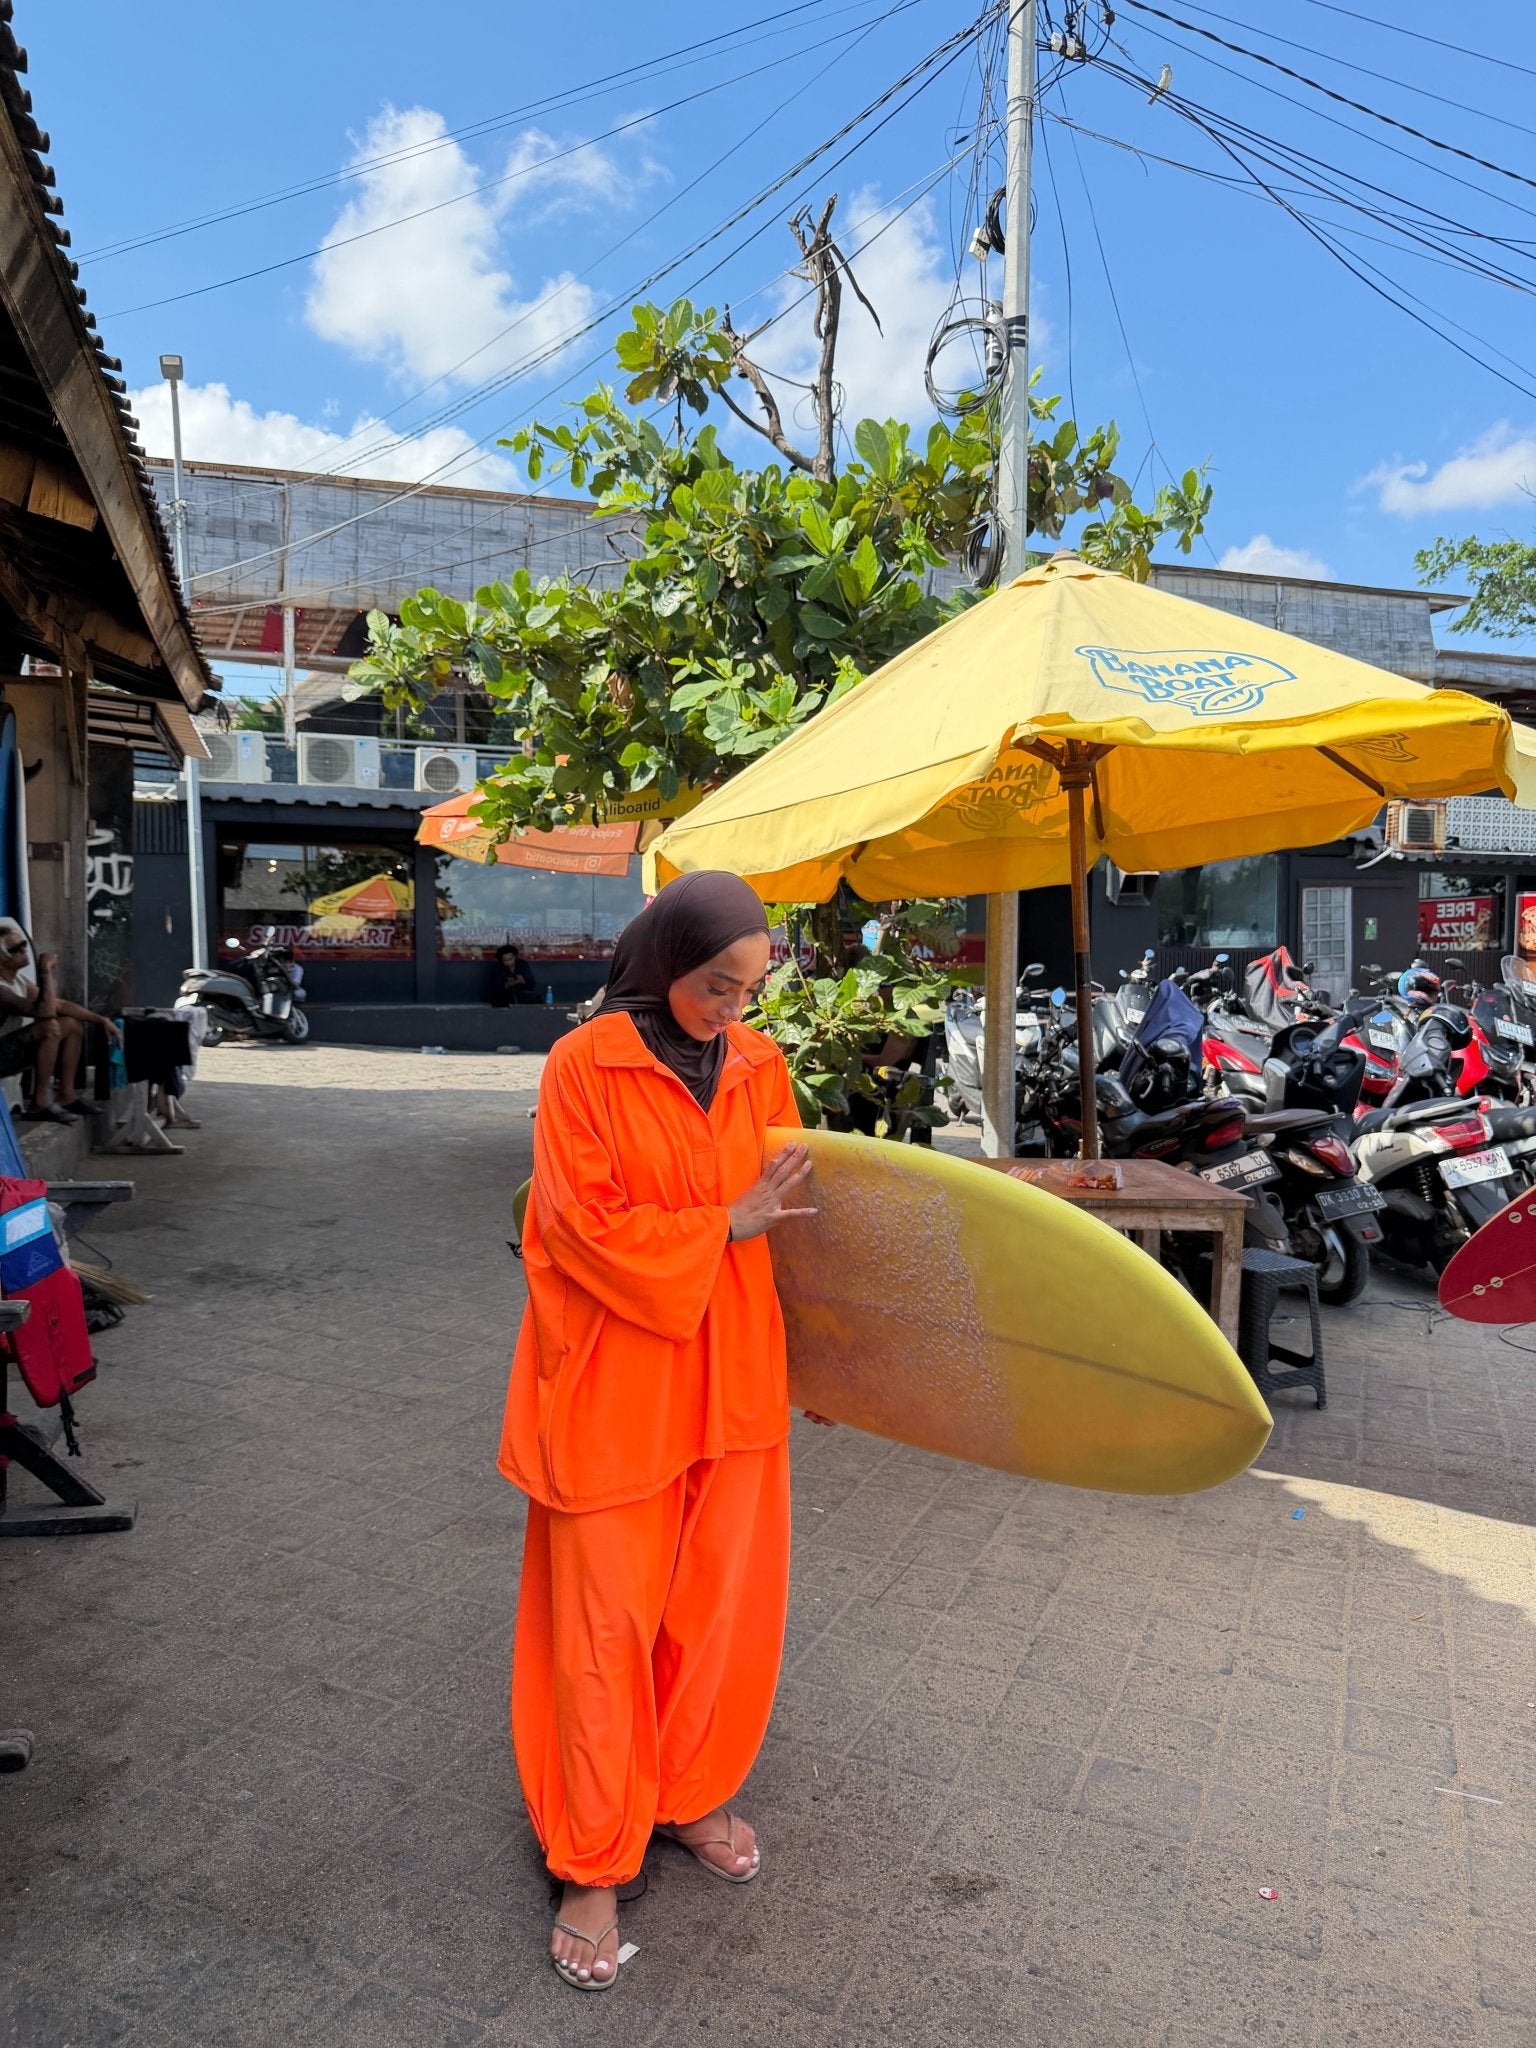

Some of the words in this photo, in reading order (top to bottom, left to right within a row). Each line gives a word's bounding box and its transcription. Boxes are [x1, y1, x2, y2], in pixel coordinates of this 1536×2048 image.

[1085, 649, 1254, 678] BANANA
[1129, 672, 1237, 700] BOAT
[603, 798, 661, 816] liboatid
[326, 924, 396, 947] MART
[1216, 1162, 1244, 1180] 6562
[1318, 1194, 1335, 1207] DK
